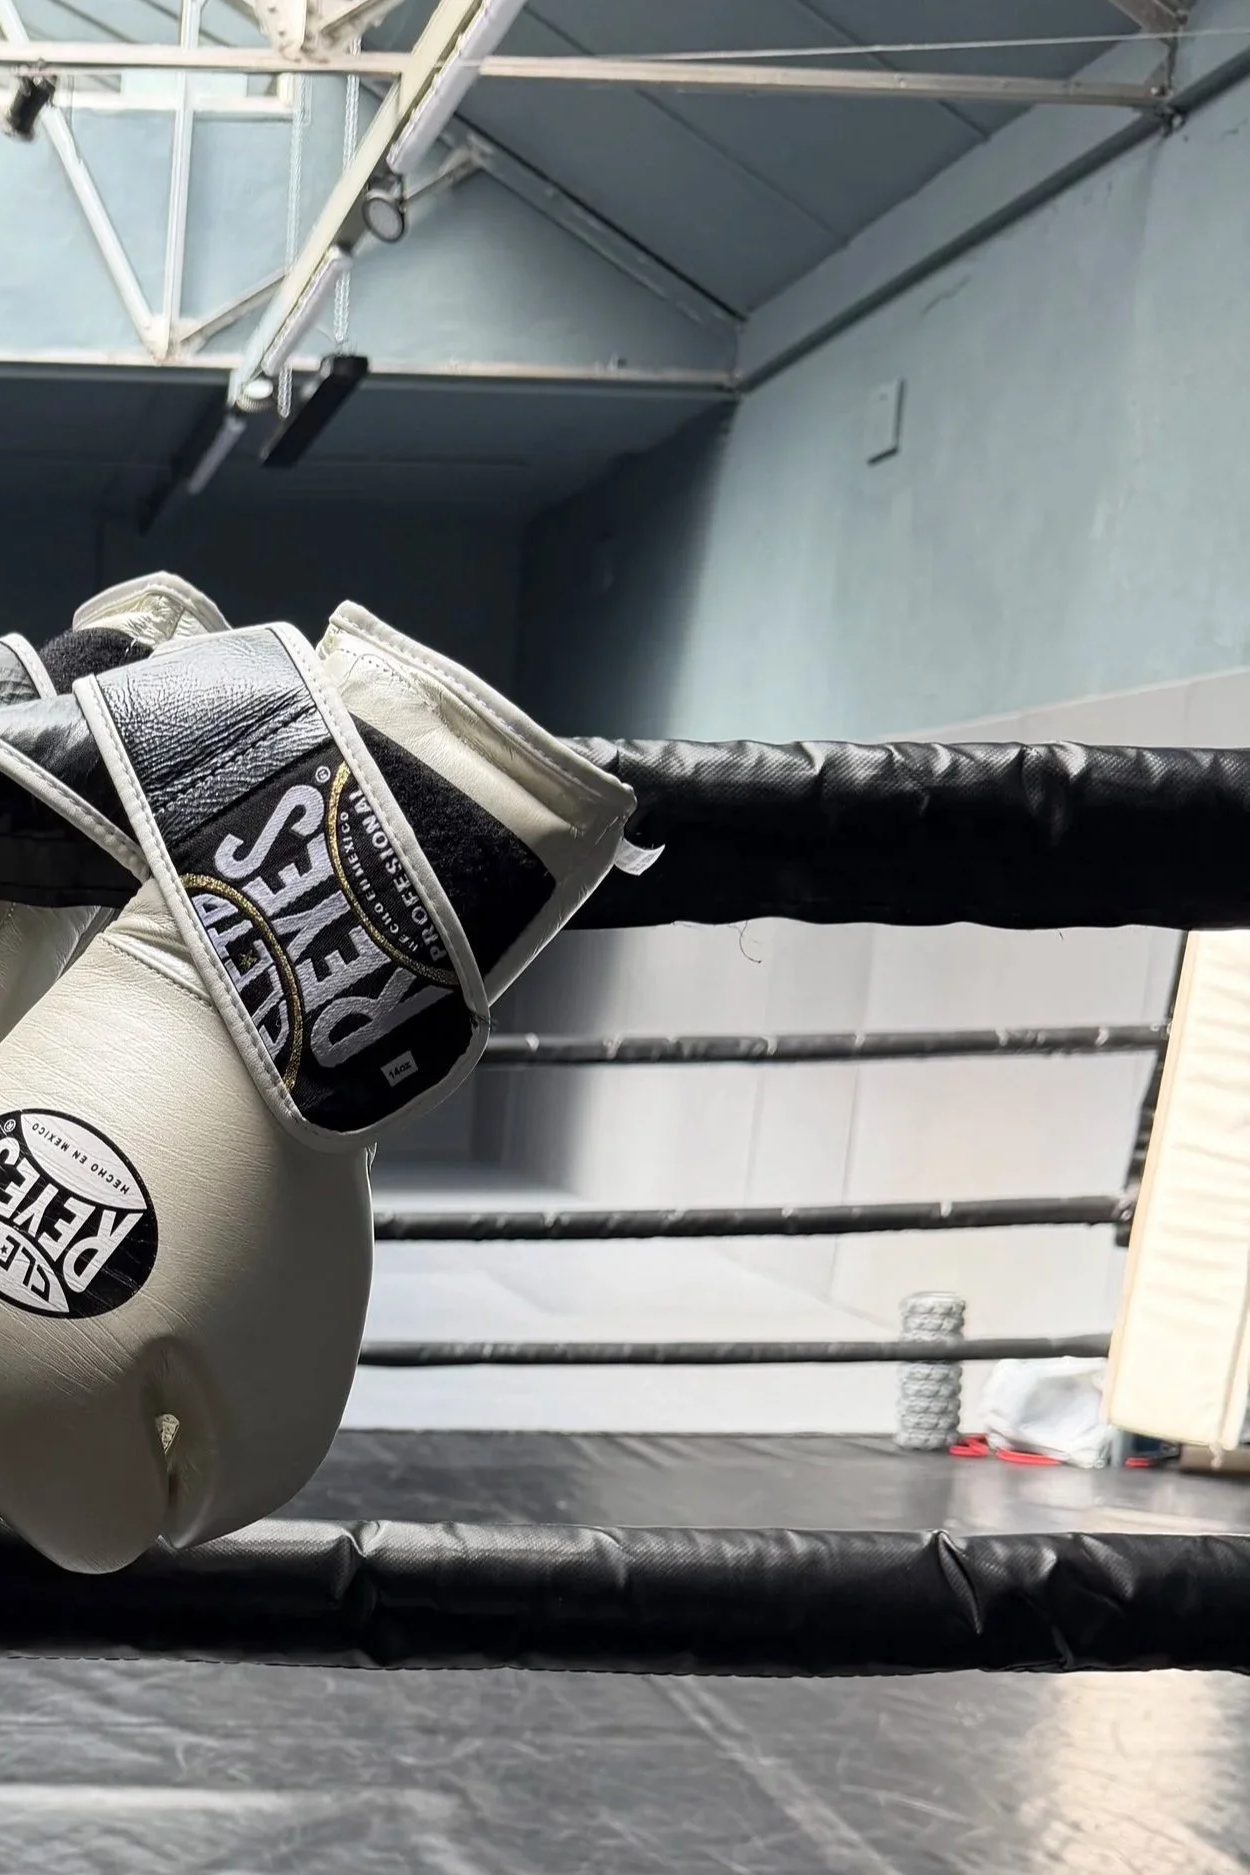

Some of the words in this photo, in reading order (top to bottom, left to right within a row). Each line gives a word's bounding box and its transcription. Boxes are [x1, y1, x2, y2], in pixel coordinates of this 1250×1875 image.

[338, 811, 367, 876] MEXICO
[215, 784, 454, 1069] REYES
[31, 1121, 70, 1153] MEXICO
[71, 1150, 87, 1166] EN
[90, 1162, 131, 1195] HECHO
